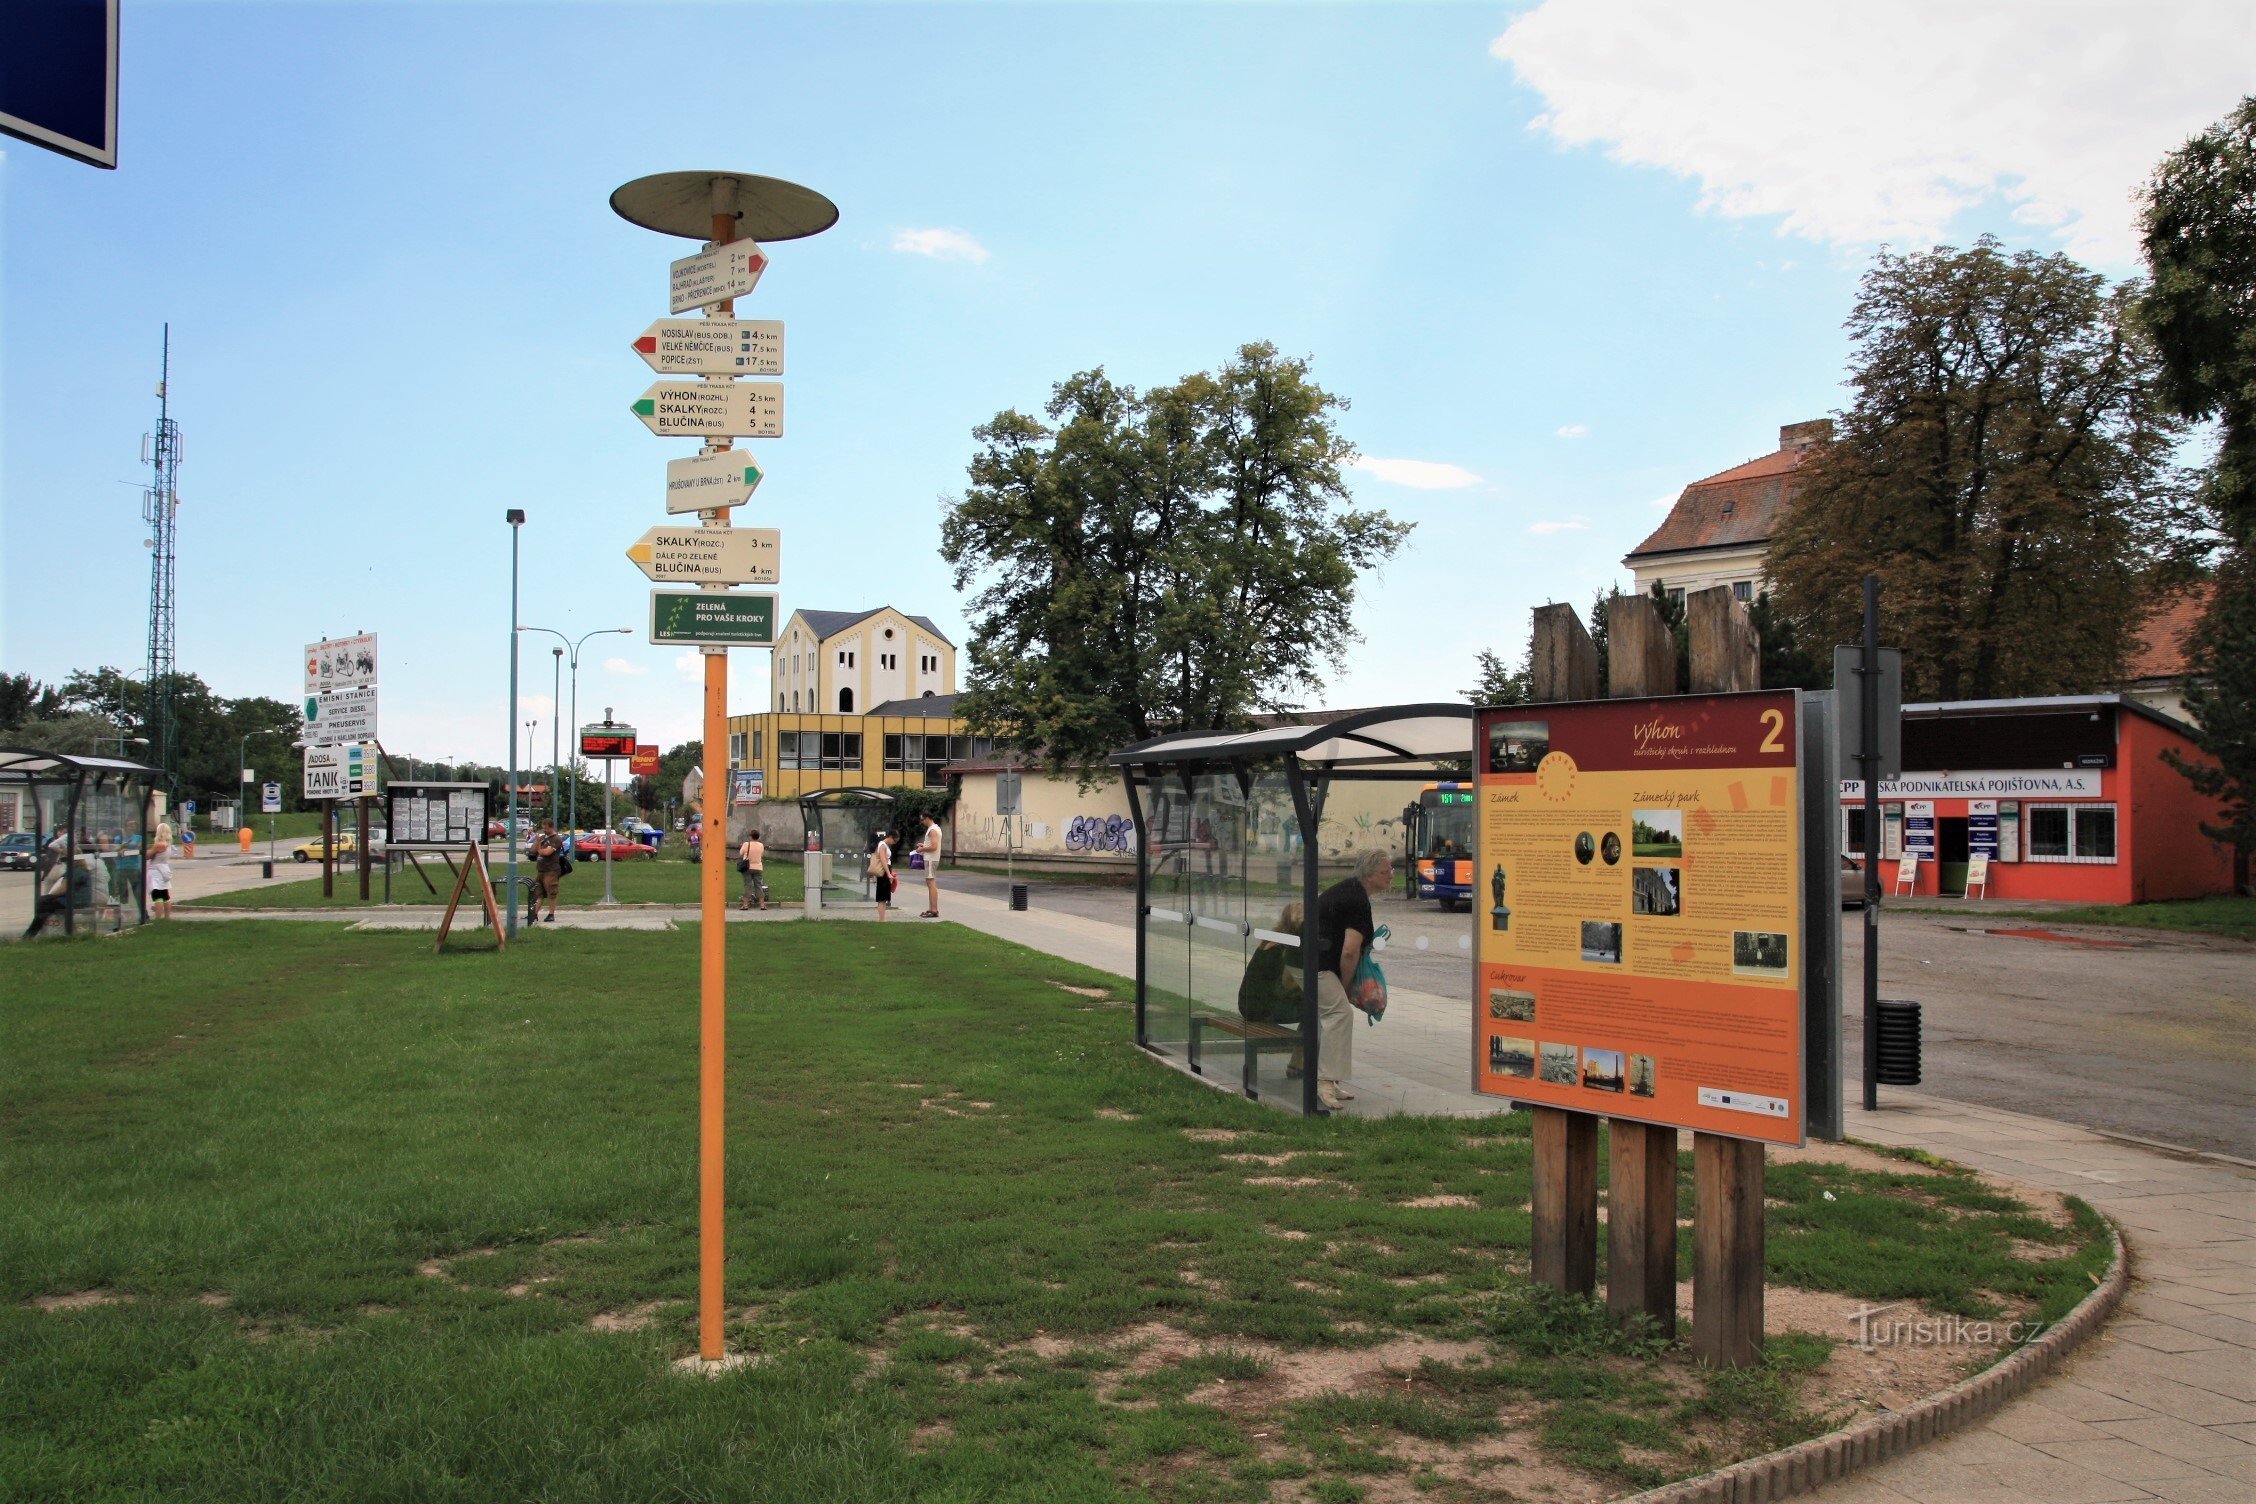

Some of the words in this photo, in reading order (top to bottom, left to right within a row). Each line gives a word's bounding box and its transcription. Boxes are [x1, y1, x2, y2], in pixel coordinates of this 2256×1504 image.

[731, 254, 735, 262] 2
[731, 267, 735, 275] 7
[727, 280, 735, 289] 14
[662, 329, 694, 339] NOSISLAV
[684, 341, 714, 352] NĚMČICE
[662, 355, 685, 364] POPICE
[660, 389, 697, 400] VÝHON
[660, 405, 702, 413] SKALKY
[749, 406, 756, 414] 4
[660, 416, 705, 427] BLUČINA
[749, 419, 756, 428] 5
[696, 478, 700, 487] U
[727, 474, 732, 483] 2
[657, 537, 698, 546] SKALKY
[752, 539, 757, 548] 3
[656, 562, 700, 572] BLUČINA
[750, 566, 756, 574] 4
[696, 603, 726, 611] ZELENÁ
[714, 613, 734, 622] VAŠE
[736, 614, 764, 623] KROKY
[319, 694, 343, 703] EMISNÍ
[346, 690, 375, 700] STANICE
[329, 707, 348, 715] SERVICE
[328, 719, 366, 728] PNEUSERVIS
[1634, 720, 1680, 750] Výhon
[1760, 709, 1784, 752] 2
[1696, 744, 1737, 754] rozhlednou
[308, 772, 338, 788] TANK
[1901, 778, 1985, 792] PODNIKATELSKÁ
[1989, 777, 2062, 793] POJIŠŤOVNA,
[2065, 779, 2085, 790] A.S.
[1441, 794, 1452, 804] 151
[1491, 792, 1519, 803] Zámek
[1632, 790, 1675, 807] Zámecký
[1678, 791, 1700, 807] park
